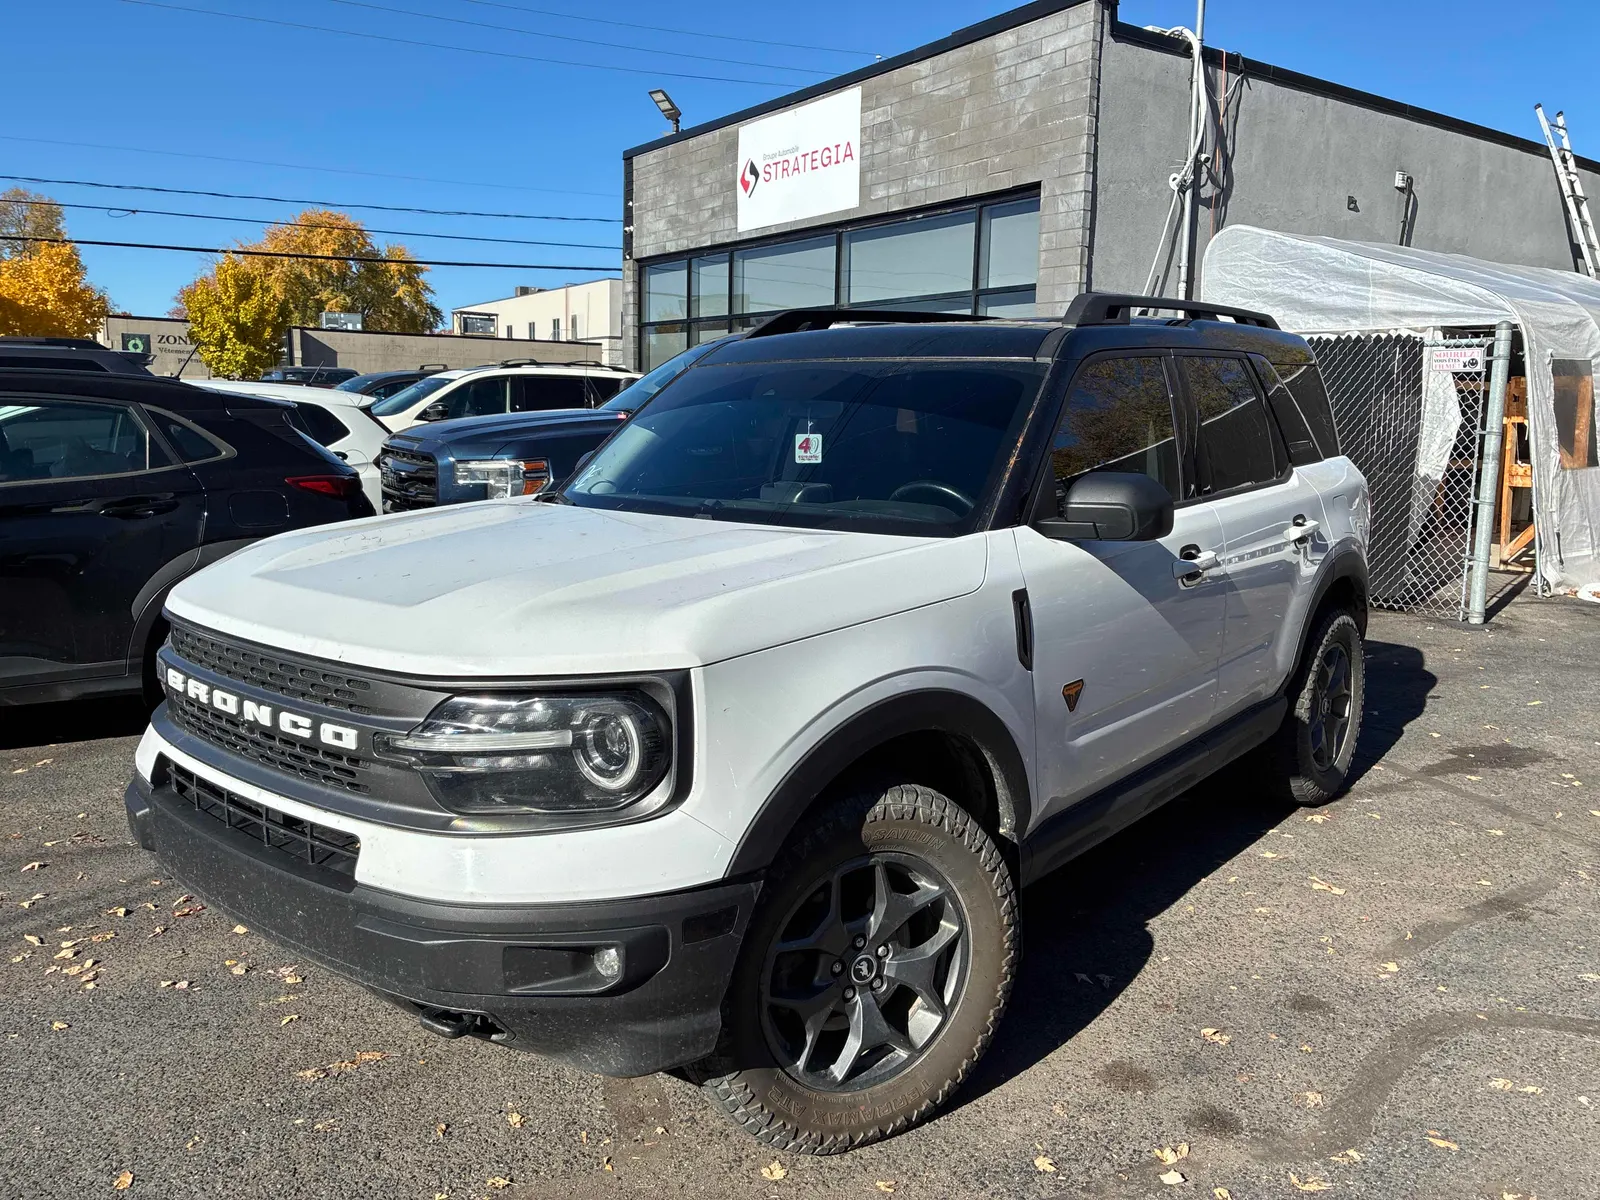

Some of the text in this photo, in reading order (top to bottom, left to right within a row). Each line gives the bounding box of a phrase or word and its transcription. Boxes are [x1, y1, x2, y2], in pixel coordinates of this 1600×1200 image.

[762, 145, 800, 161] Groupe Automobile
[763, 141, 854, 183] STRATEGIA
[167, 668, 358, 750] BRONCO
[872, 828, 946, 850] SAILUN
